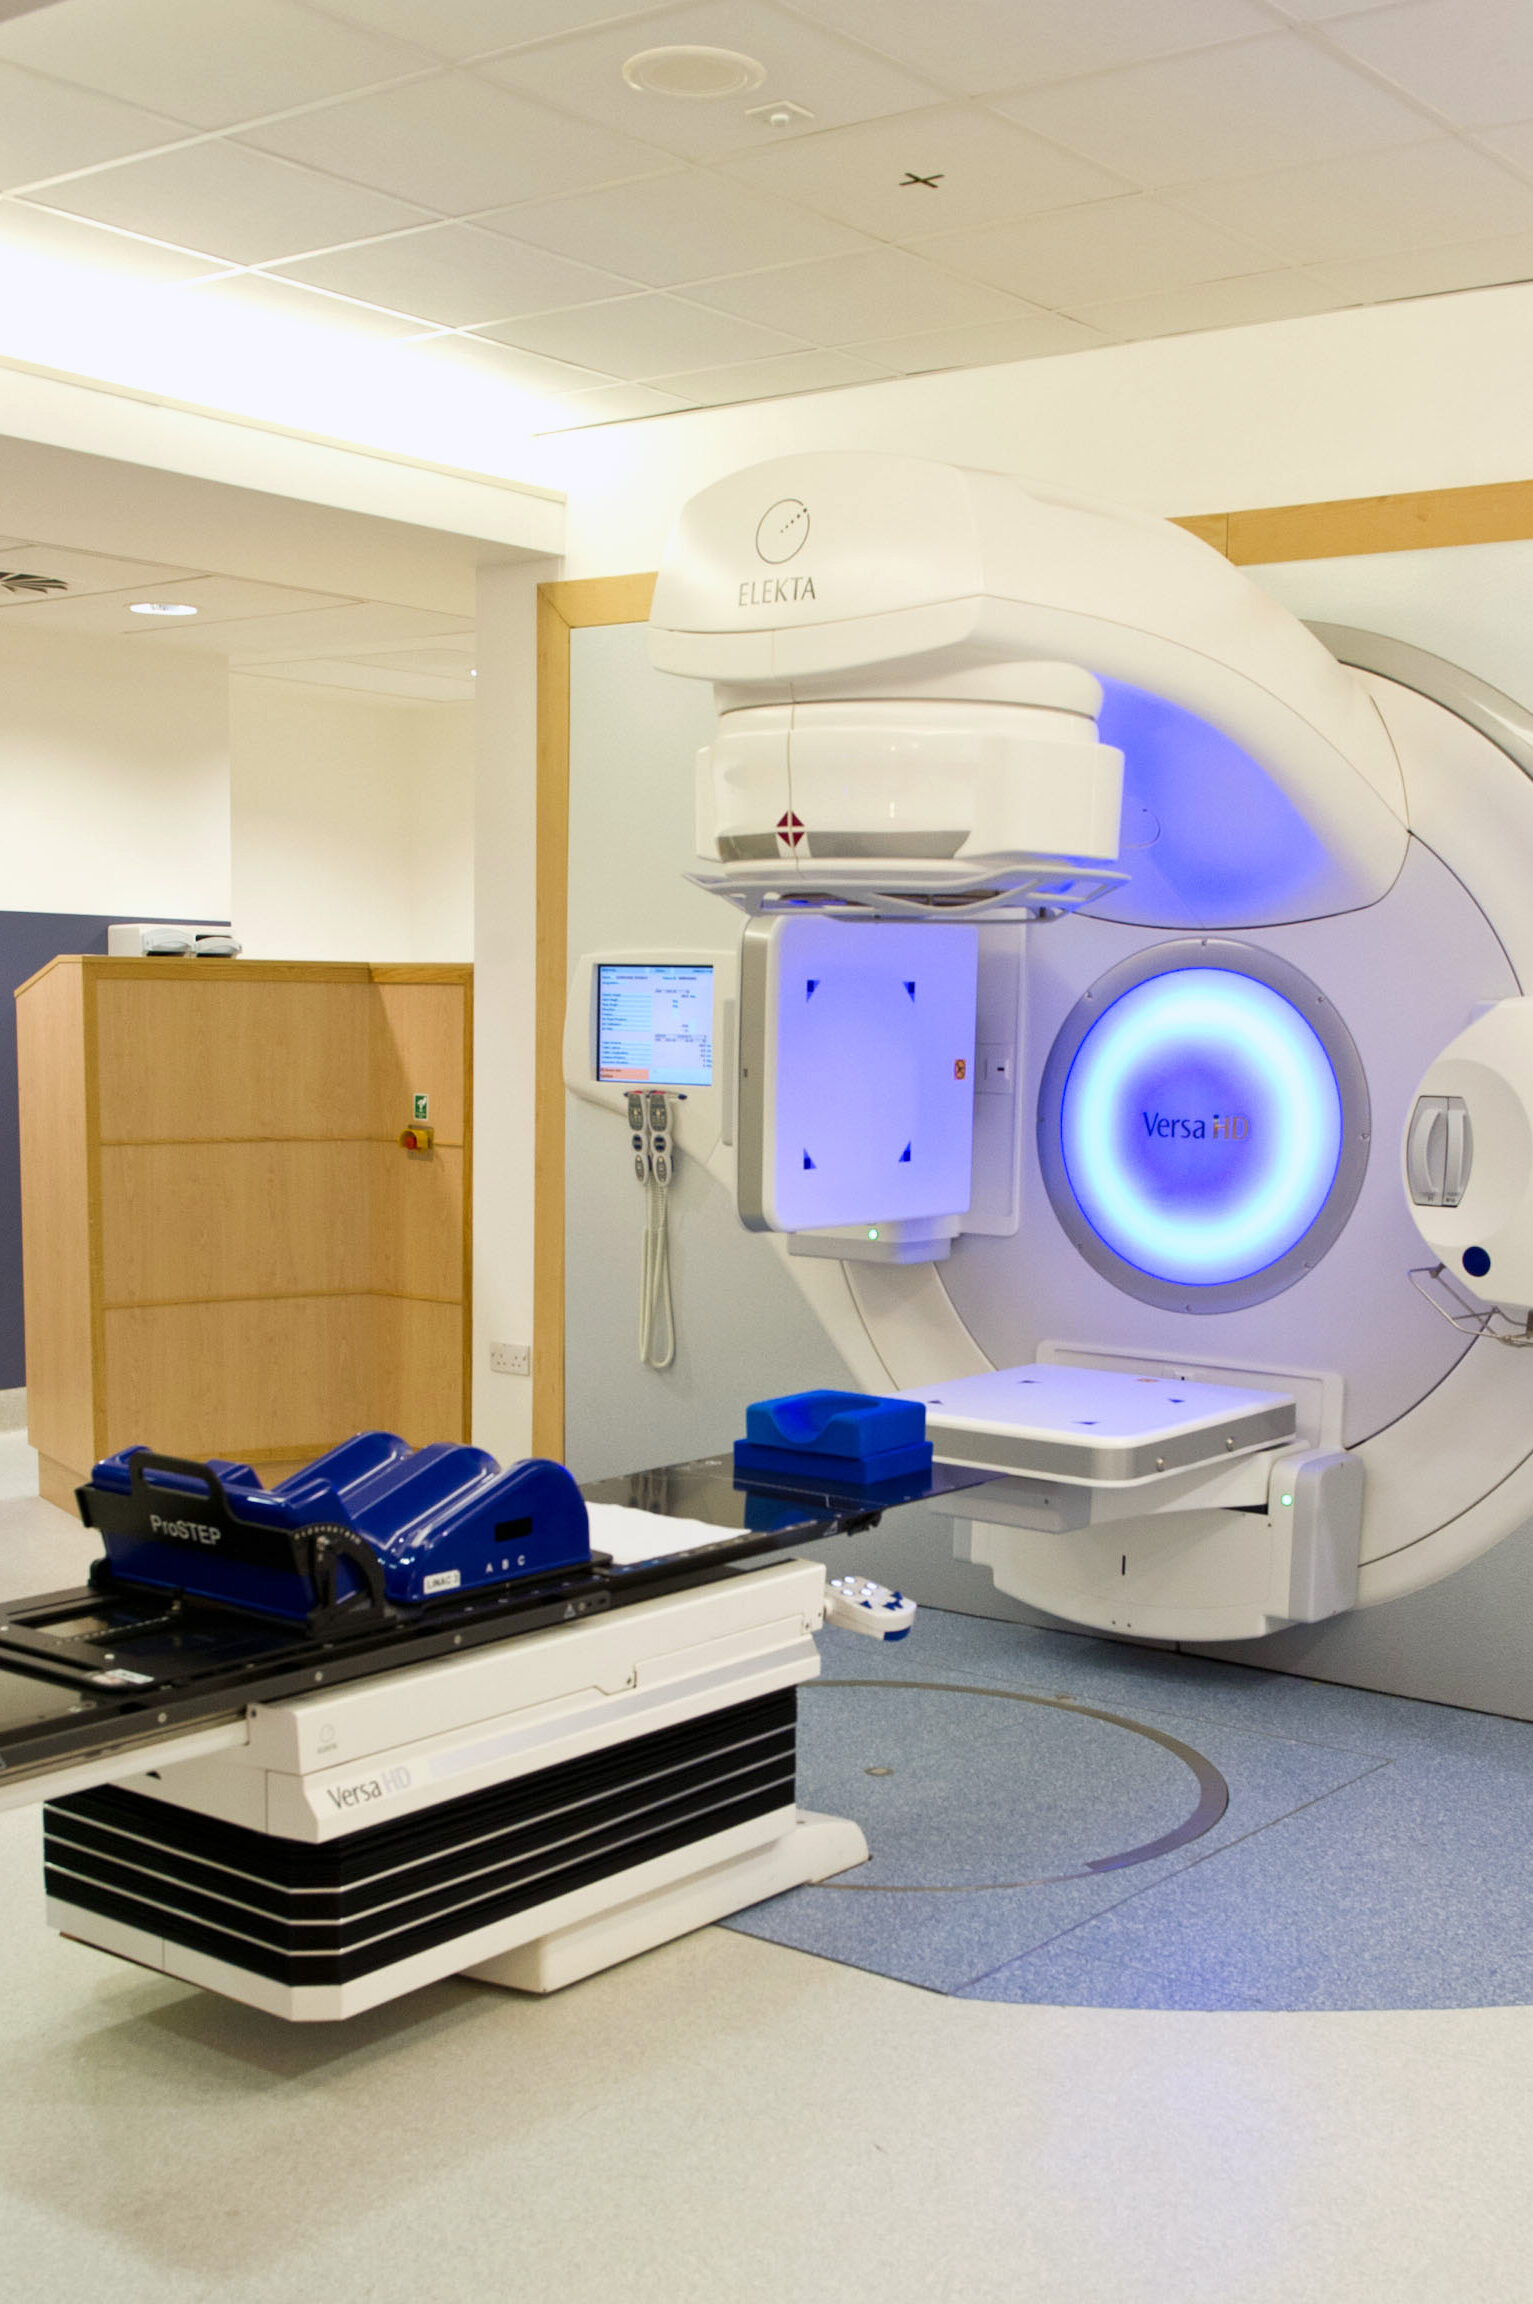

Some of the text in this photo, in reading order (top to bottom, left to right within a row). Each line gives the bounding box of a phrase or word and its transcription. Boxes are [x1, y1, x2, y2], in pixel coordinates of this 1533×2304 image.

[738, 576, 816, 607] ELEKTA
[1142, 1111, 1249, 1140] Versa HD
[149, 1513, 222, 1546] ProSTEP
[486, 1562, 493, 1574] A
[517, 1554, 525, 1566] C
[326, 1765, 412, 1810] Versa HD
